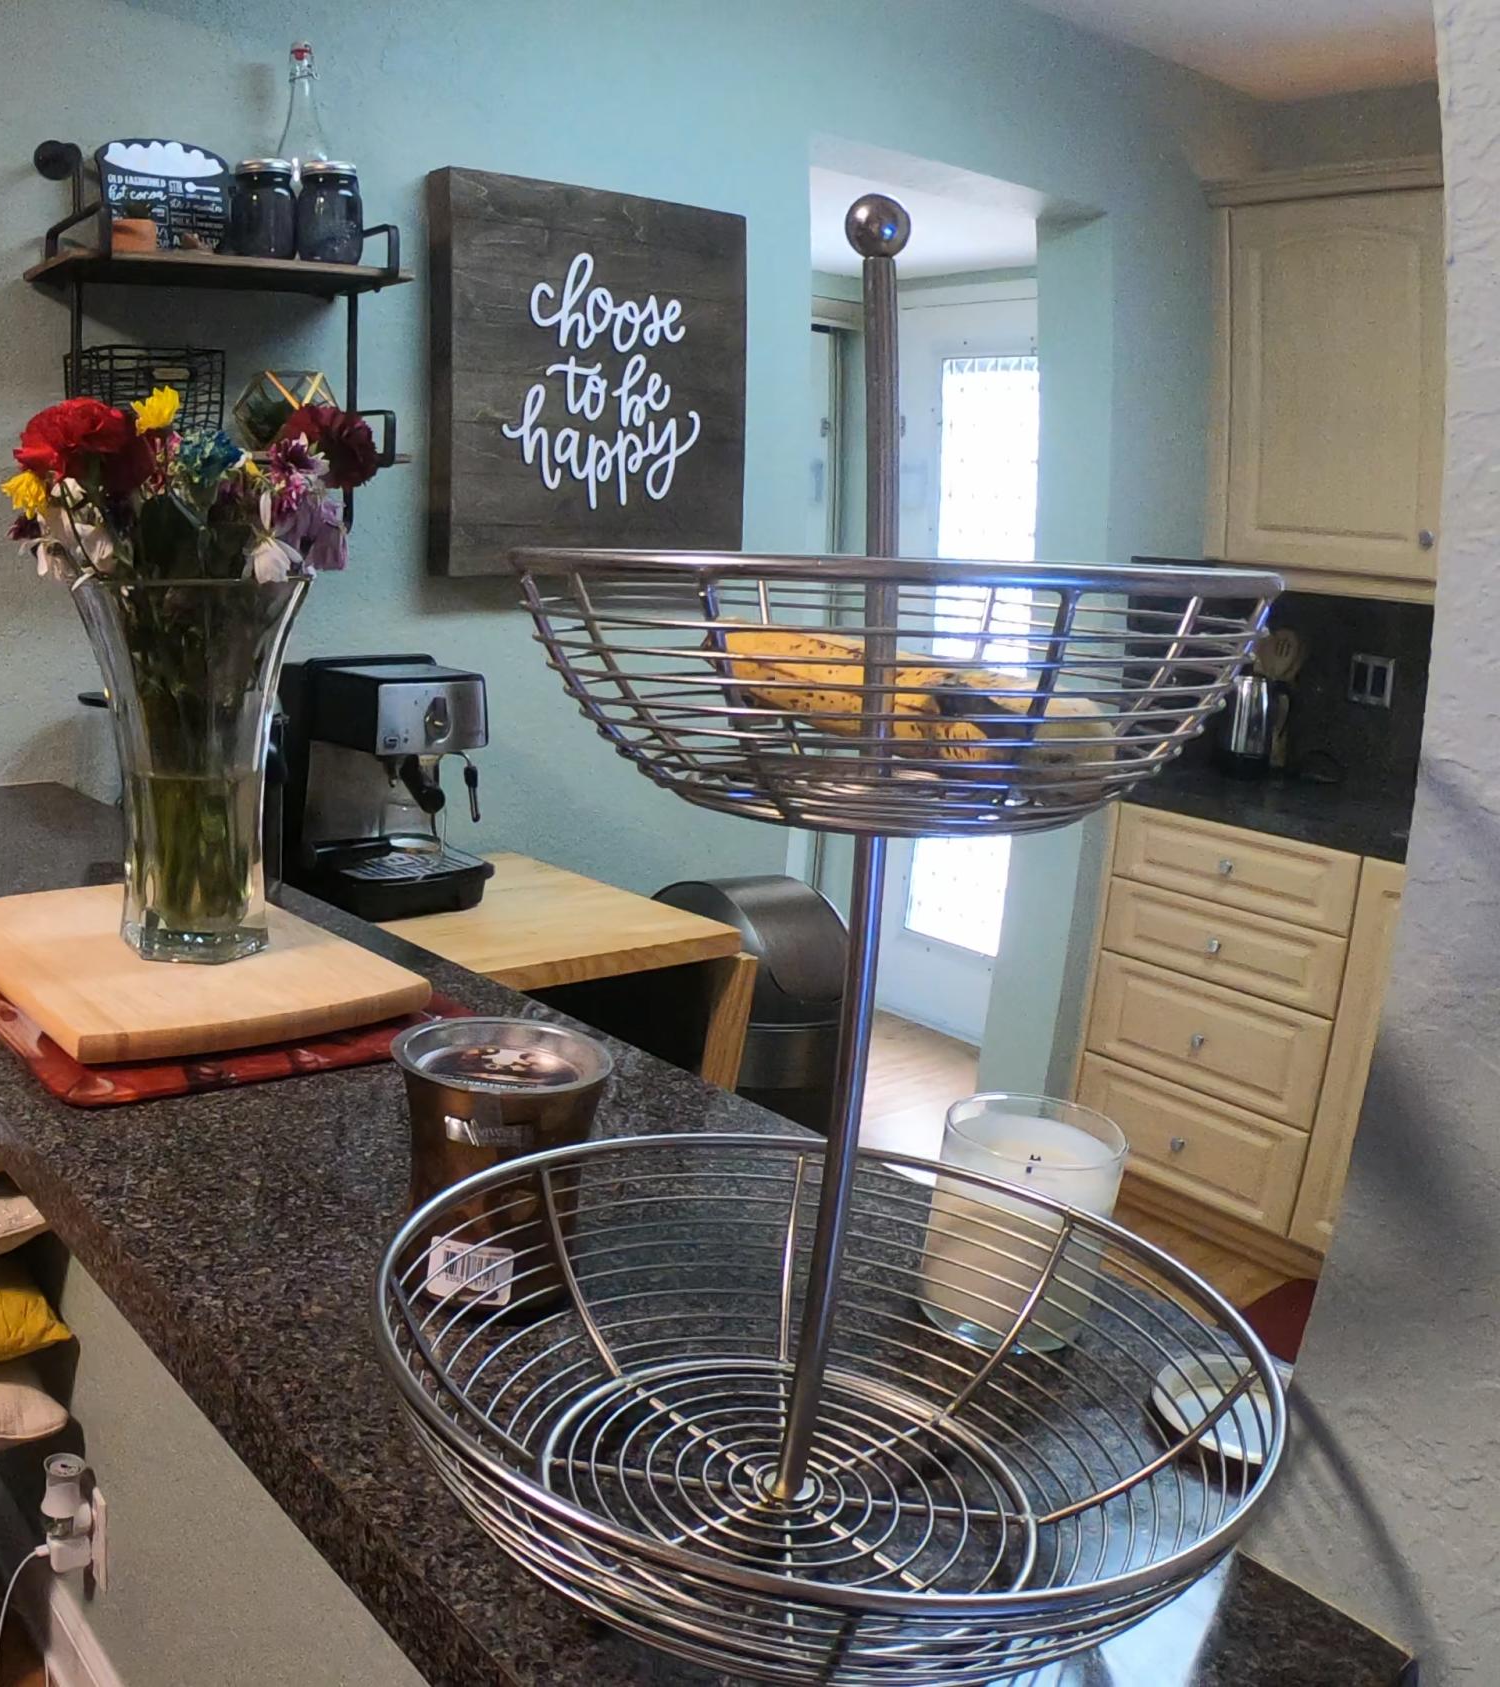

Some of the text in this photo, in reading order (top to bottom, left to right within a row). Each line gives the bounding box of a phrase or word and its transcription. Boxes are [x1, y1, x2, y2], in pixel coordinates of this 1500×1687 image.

[107, 174, 123, 183] OLD
[130, 190, 168, 201] cocoa
[530, 252, 686, 353] choose
[546, 354, 671, 427] to be
[502, 384, 700, 510] happy
